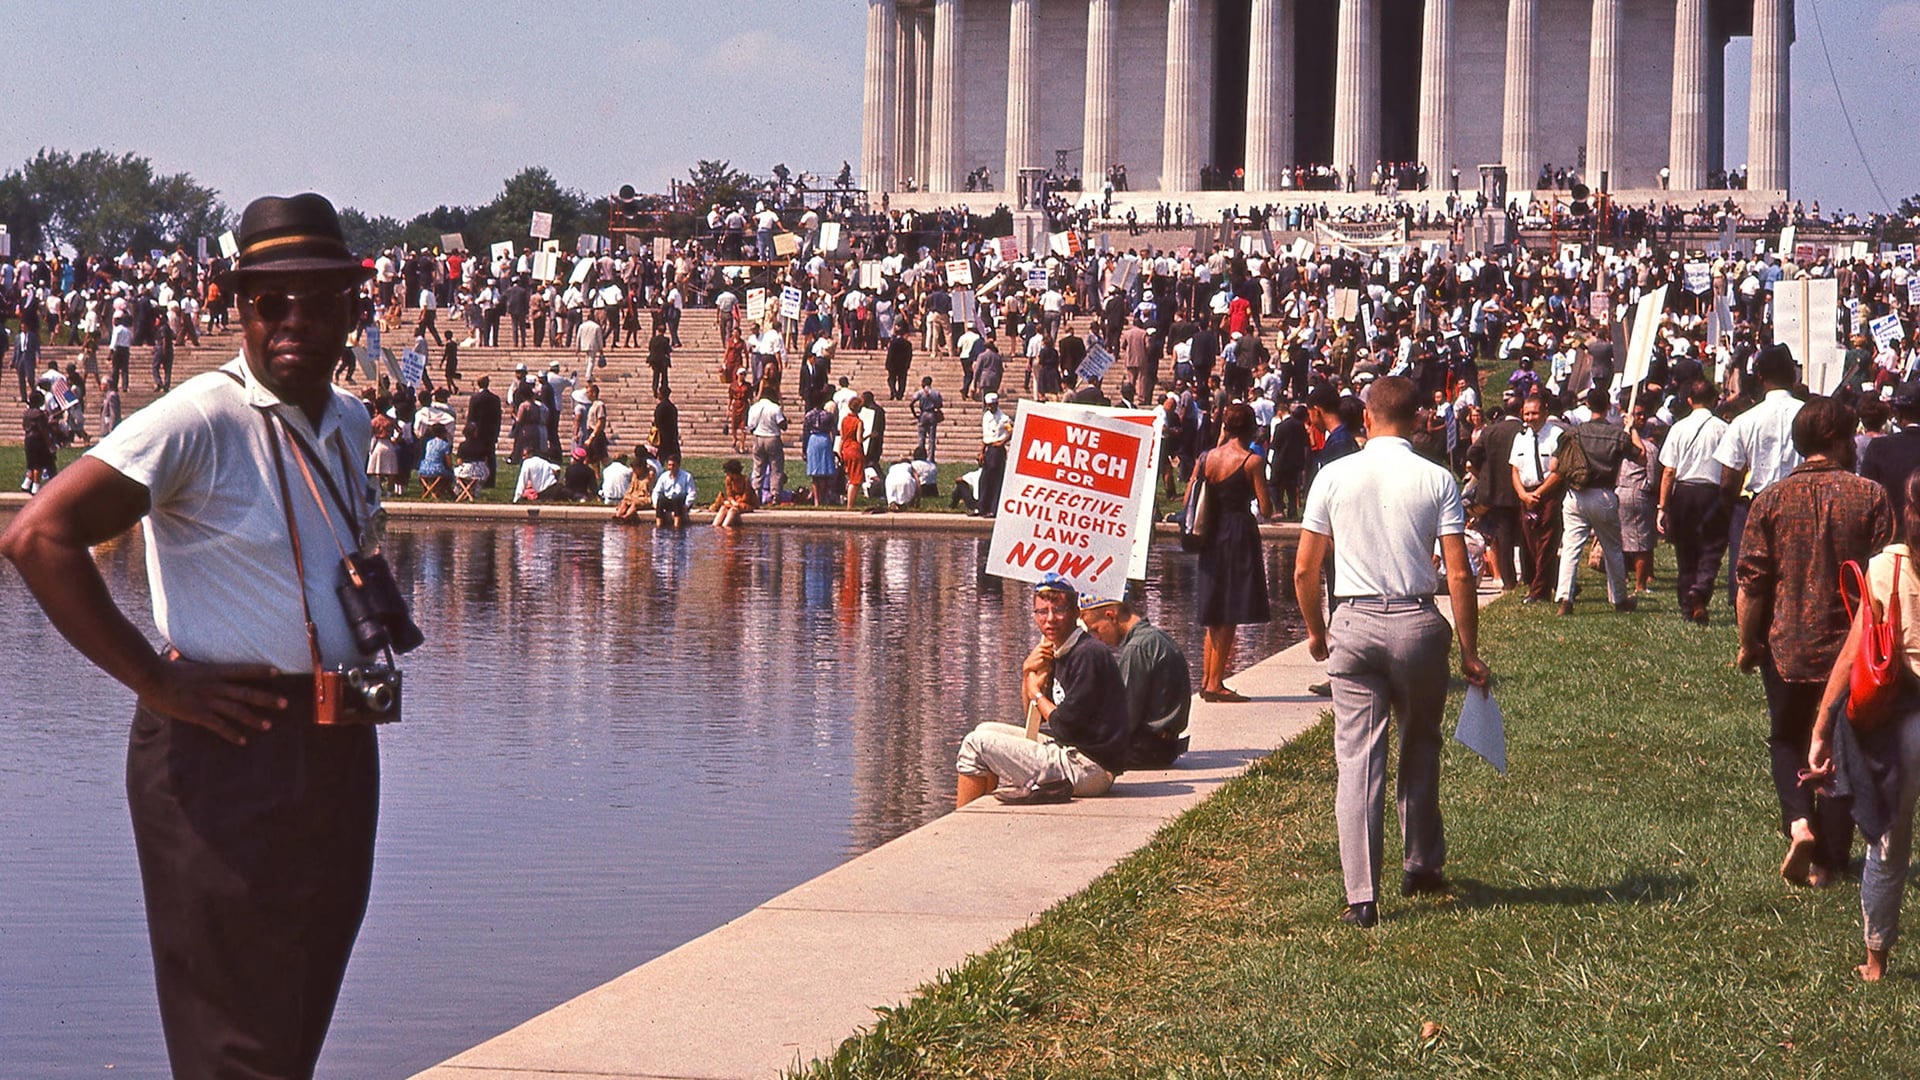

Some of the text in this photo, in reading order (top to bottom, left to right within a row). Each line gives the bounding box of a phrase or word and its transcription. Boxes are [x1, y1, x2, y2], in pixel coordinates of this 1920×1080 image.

[1065, 425, 1101, 448] WE
[1026, 439, 1128, 480] MARCH
[1055, 470, 1095, 487] FOR
[1021, 484, 1123, 518] EFFECTIVE
[1004, 499, 1128, 538] CIVIL RIGHTS
[1033, 525, 1090, 549] LAWS
[1006, 541, 1114, 583] NOW!
